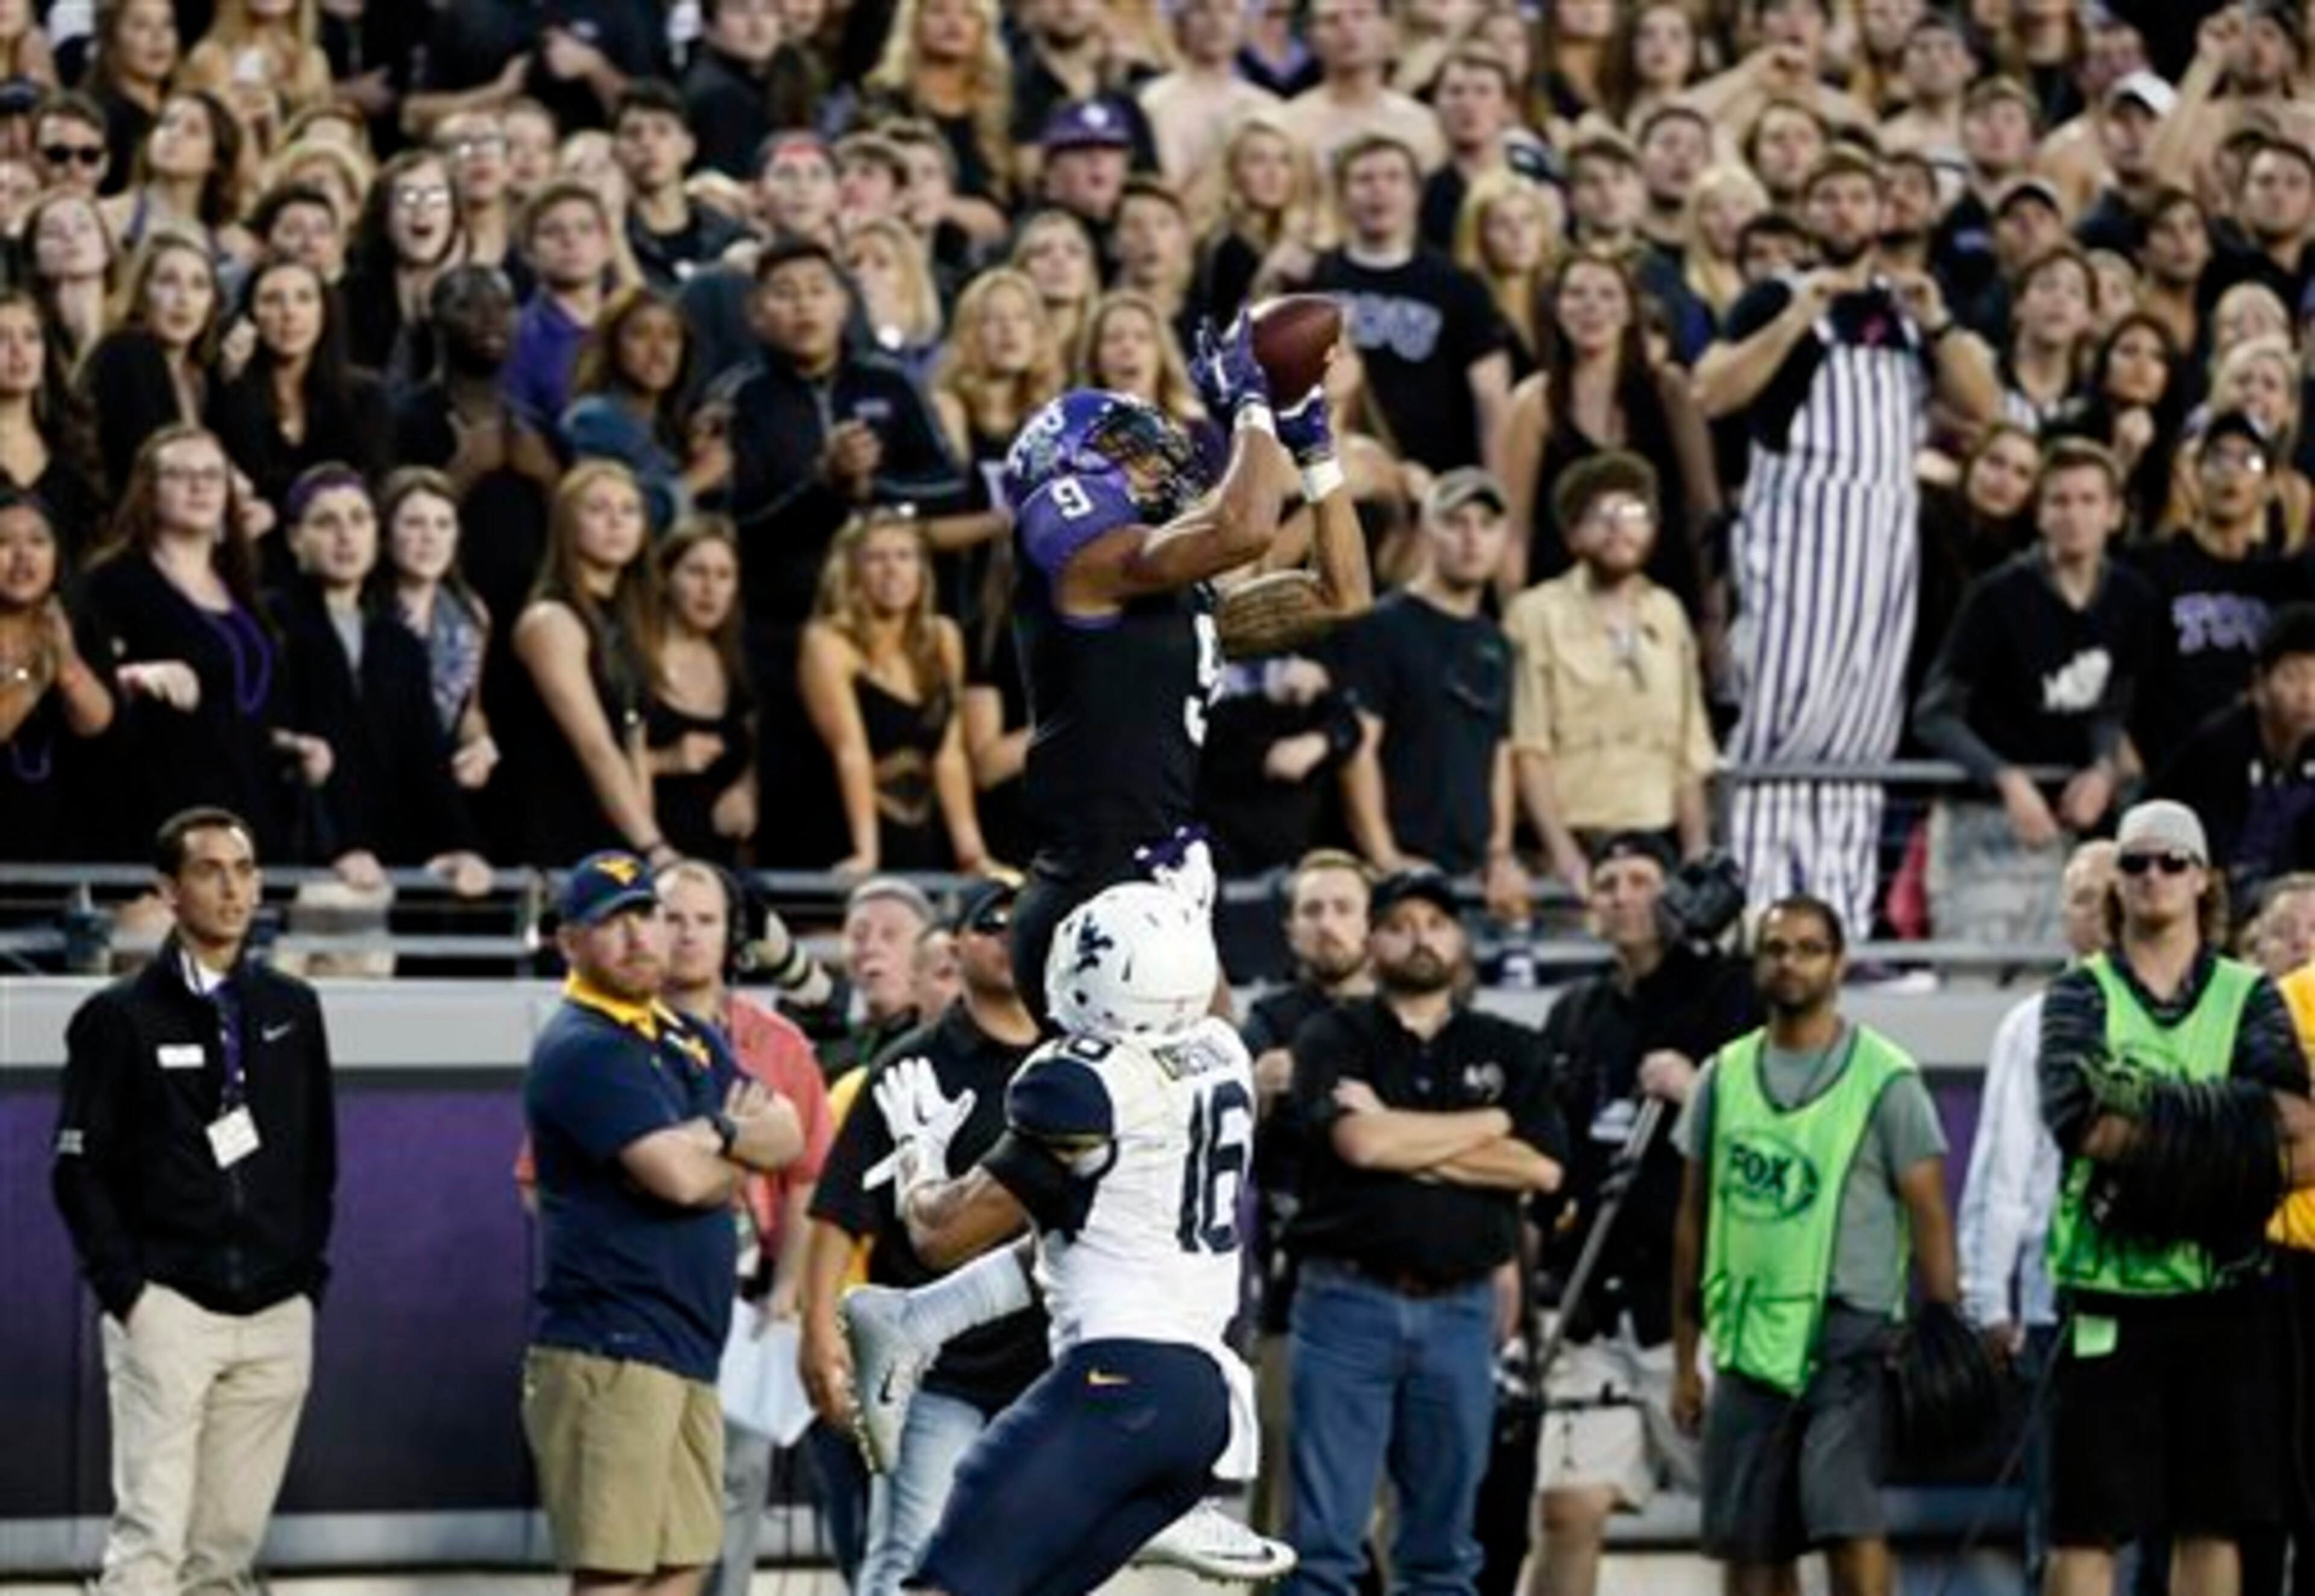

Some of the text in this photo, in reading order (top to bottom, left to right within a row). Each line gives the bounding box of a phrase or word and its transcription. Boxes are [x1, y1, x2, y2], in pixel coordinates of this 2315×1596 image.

[1051, 478, 1092, 518] 9
[1176, 1080, 1253, 1254] 16
[1728, 1143, 1792, 1193] FOX
